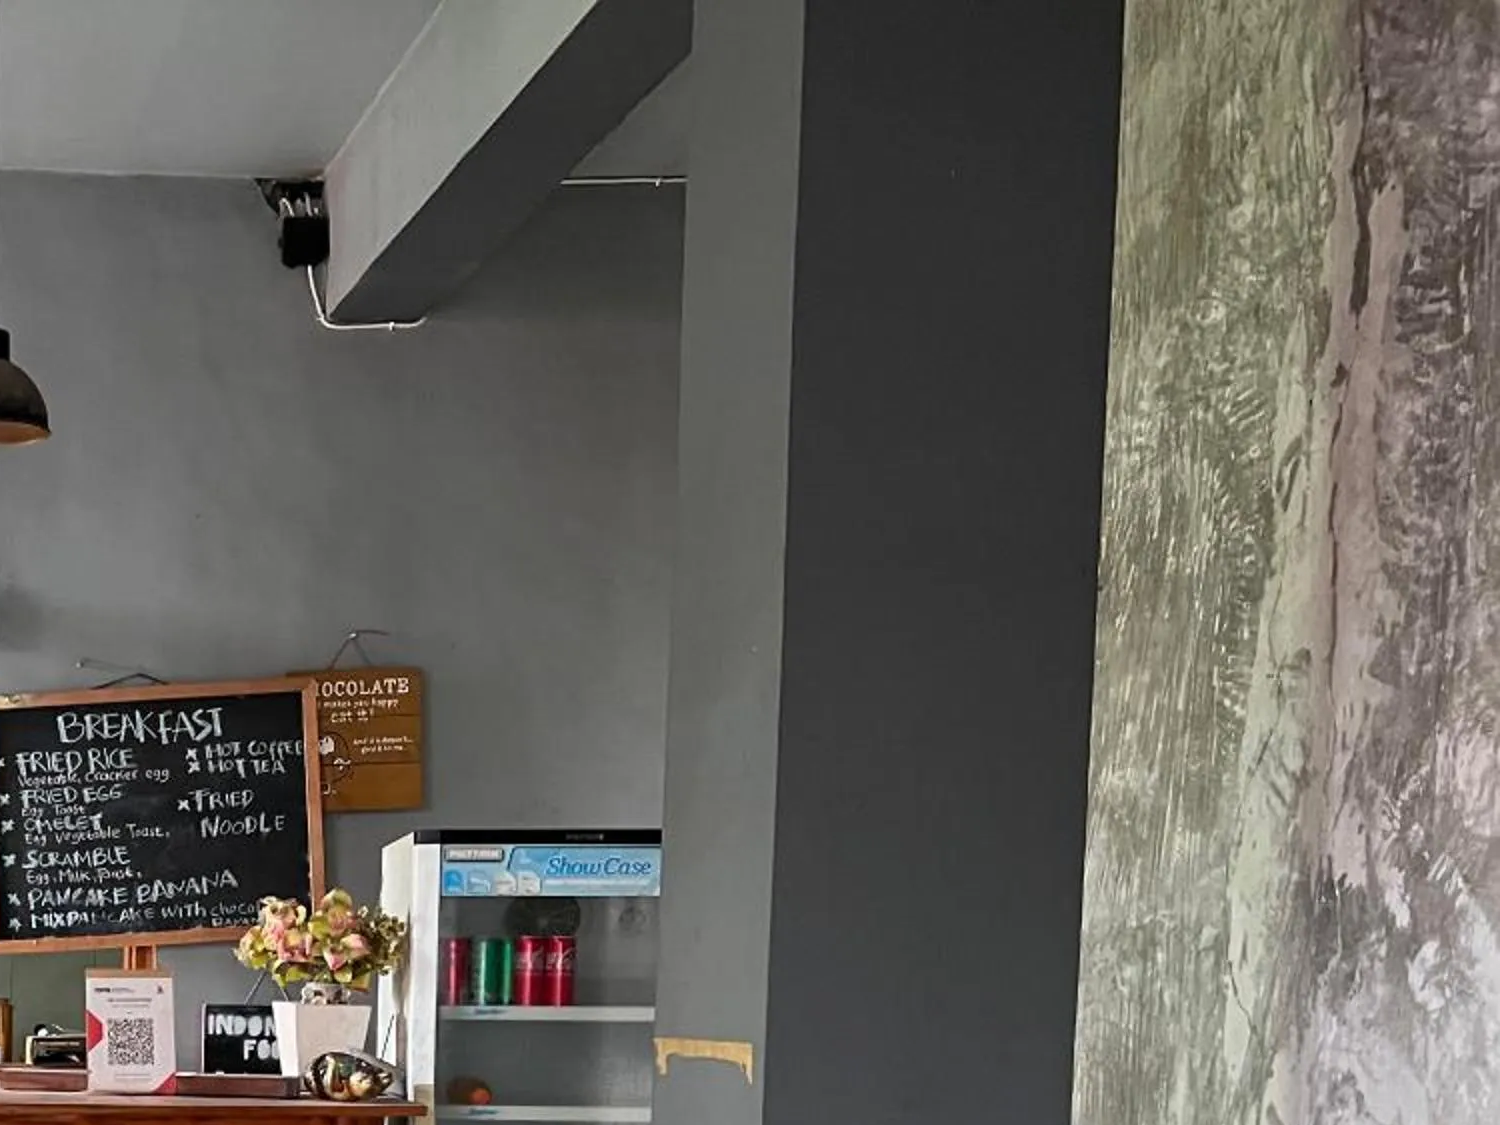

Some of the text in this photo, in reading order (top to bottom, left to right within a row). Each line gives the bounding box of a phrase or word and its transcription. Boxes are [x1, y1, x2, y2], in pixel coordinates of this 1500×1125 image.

[316, 677, 410, 698] OCOLATE
[56, 707, 223, 745] BREAKFAST
[205, 741, 241, 759] HOT
[16, 748, 138, 777] FRIED RICE
[207, 758, 286, 778] HOT TEA
[145, 769, 169, 783] egg
[20, 784, 125, 808] FRIED EGG
[189, 788, 254, 812] FRIED
[23, 812, 103, 834] OMELET
[201, 812, 285, 838] NOODLE
[22, 846, 131, 869] SCRAMBLE
[27, 869, 239, 910] PANCAKE BANANA
[208, 1013, 277, 1037] INDON
[243, 1039, 280, 1060] FOO
